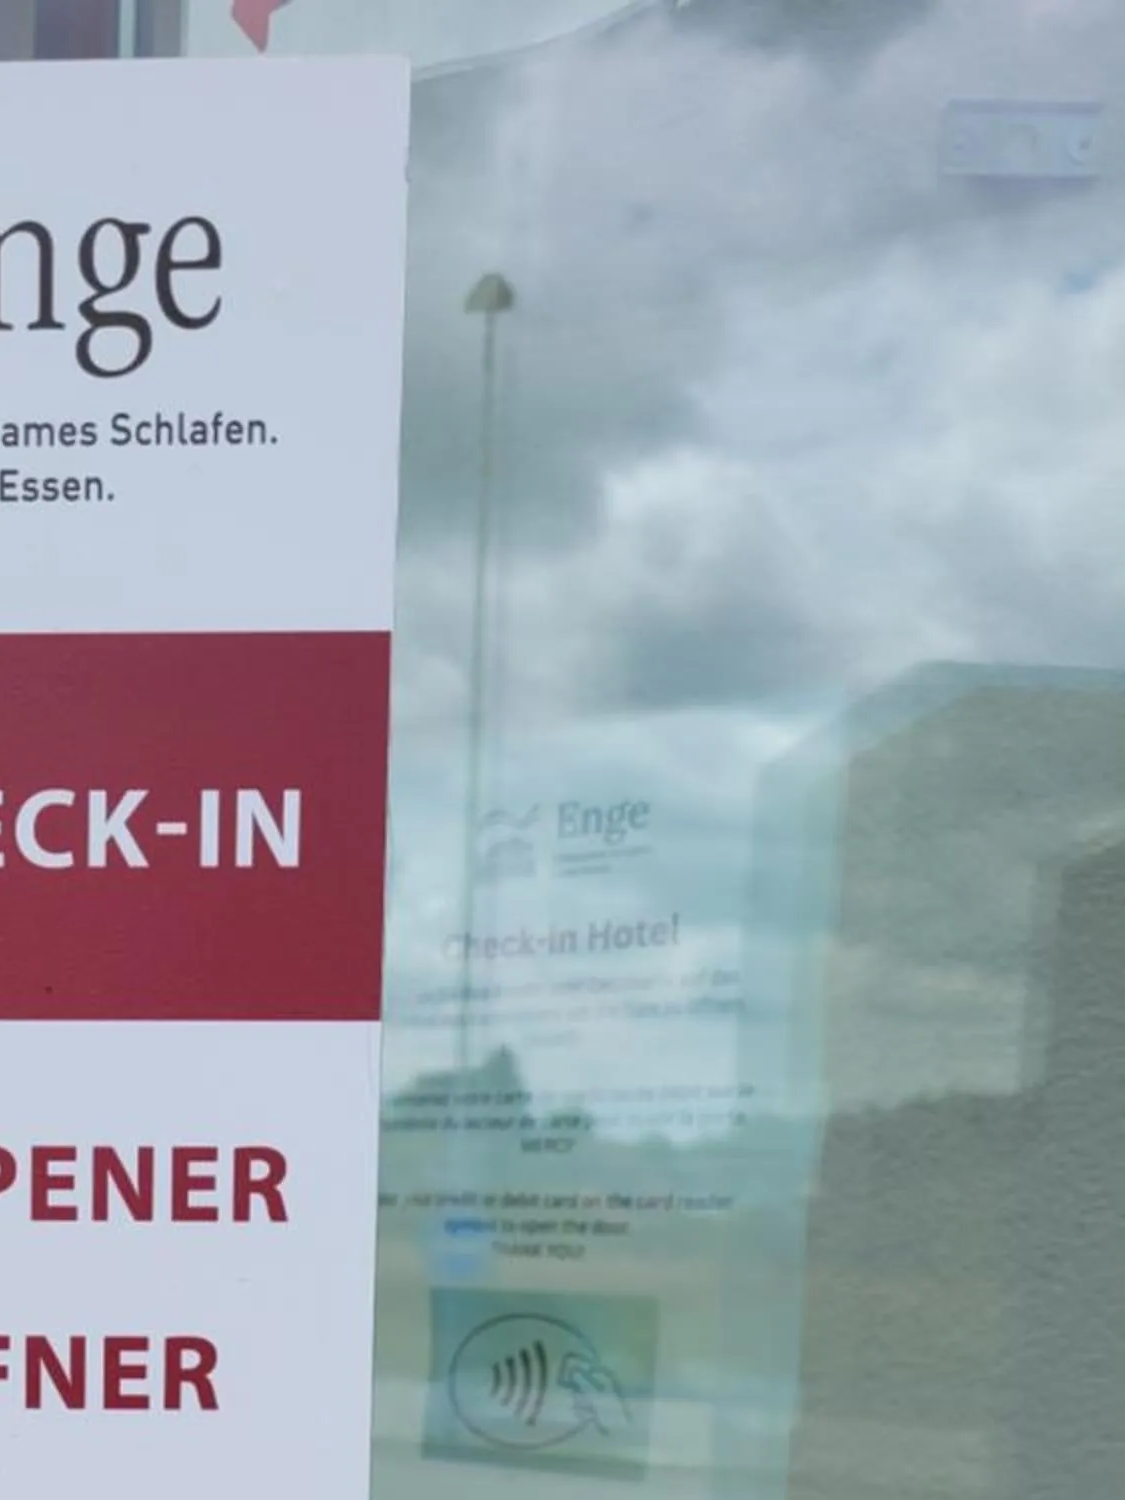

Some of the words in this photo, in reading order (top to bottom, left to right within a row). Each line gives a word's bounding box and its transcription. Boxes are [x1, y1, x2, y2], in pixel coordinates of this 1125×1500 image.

[110, 411, 278, 447] Schlafen.
[557, 800, 650, 844] Enge
[441, 927, 576, 961] Check-in
[588, 913, 679, 954] Hotel
